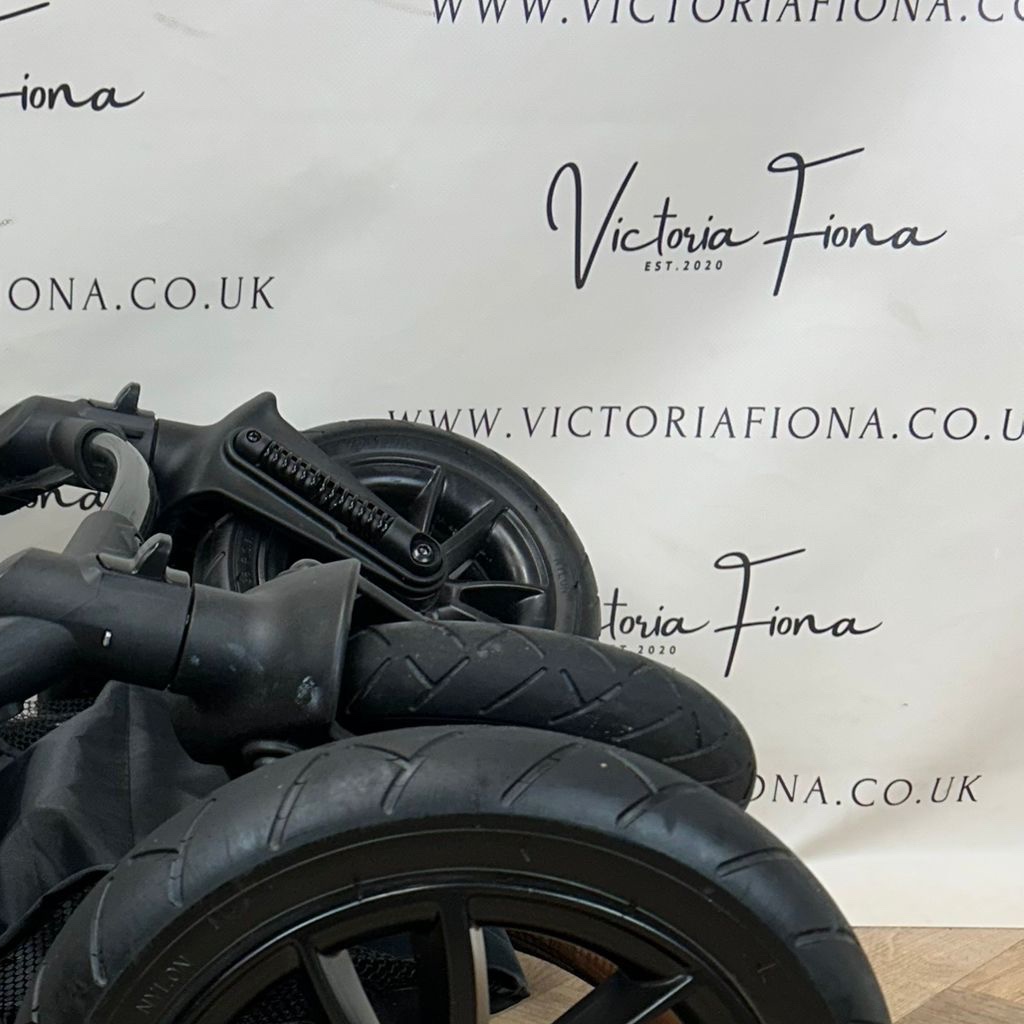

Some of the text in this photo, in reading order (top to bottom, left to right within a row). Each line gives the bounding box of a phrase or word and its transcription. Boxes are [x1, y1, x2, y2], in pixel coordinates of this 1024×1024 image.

[546, 147, 947, 296] Victoria Fiona
[645, 260, 722, 271] EST.2020
[714, 549, 882, 678] Fiona
